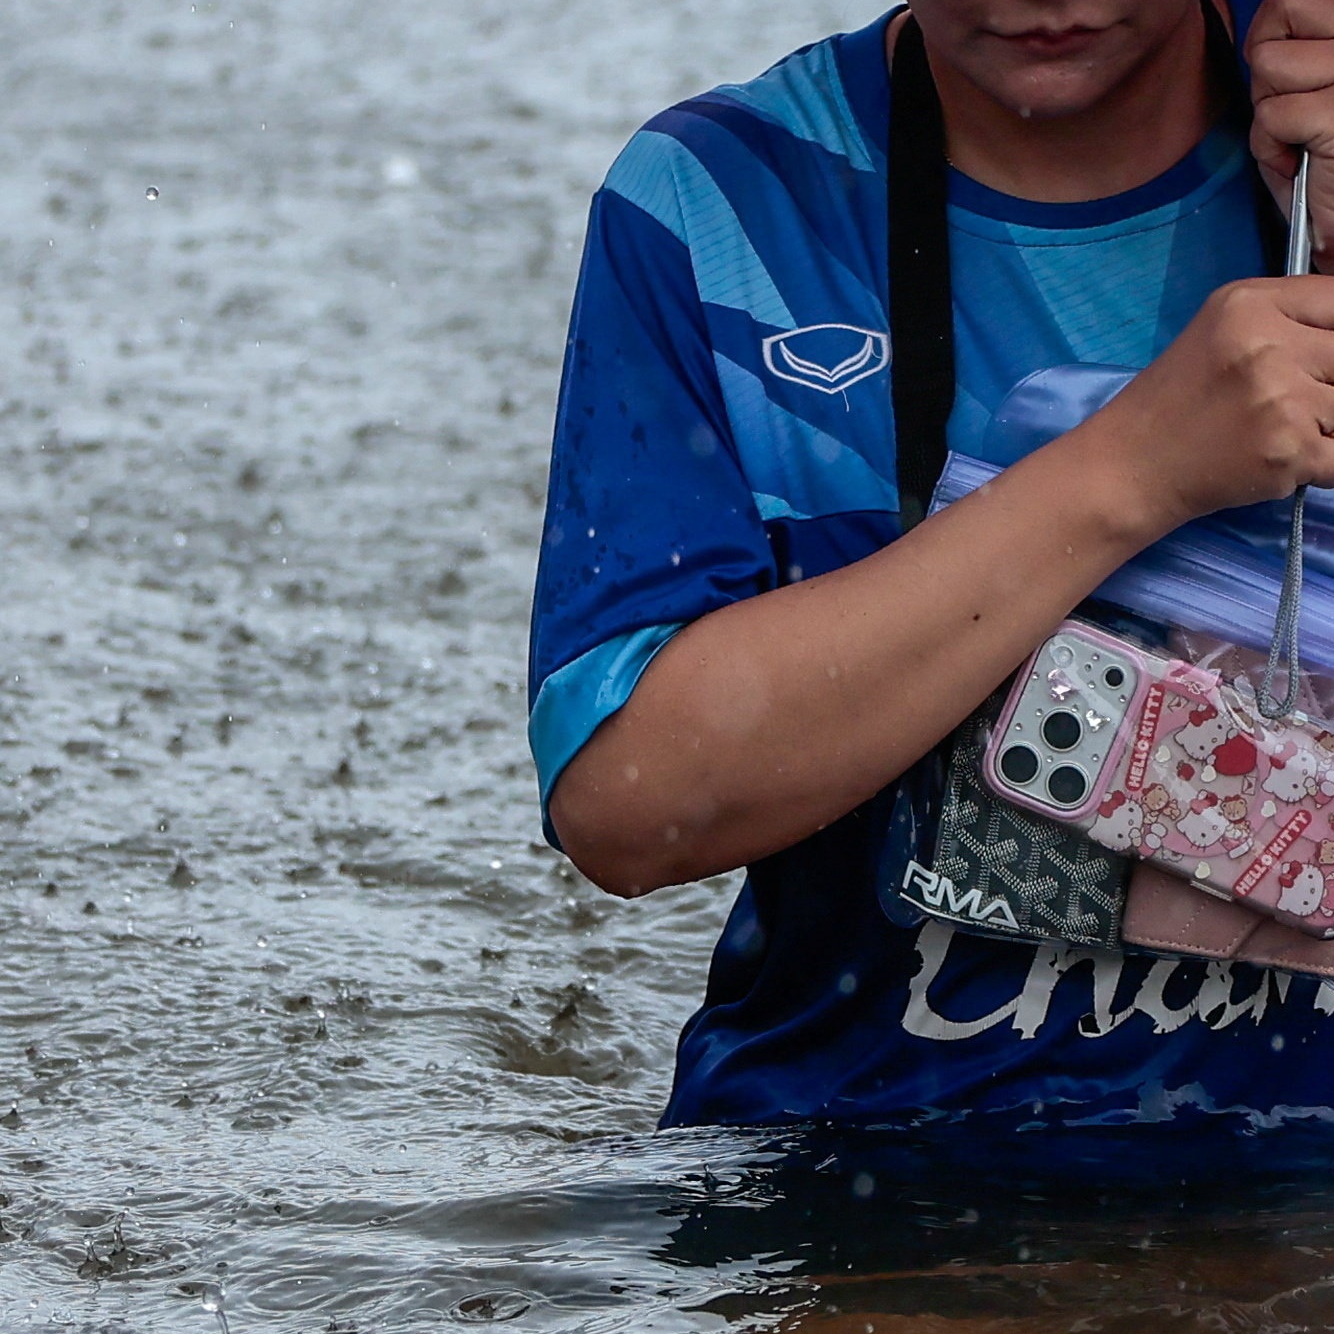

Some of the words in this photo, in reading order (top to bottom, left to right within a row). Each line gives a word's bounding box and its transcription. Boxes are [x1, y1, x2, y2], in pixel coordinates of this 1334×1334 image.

[1128, 739, 1150, 788] HELLO
[1140, 687, 1162, 737] KITTY
[1235, 854, 1273, 896] HELLO
[1268, 812, 1308, 856] KITTY
